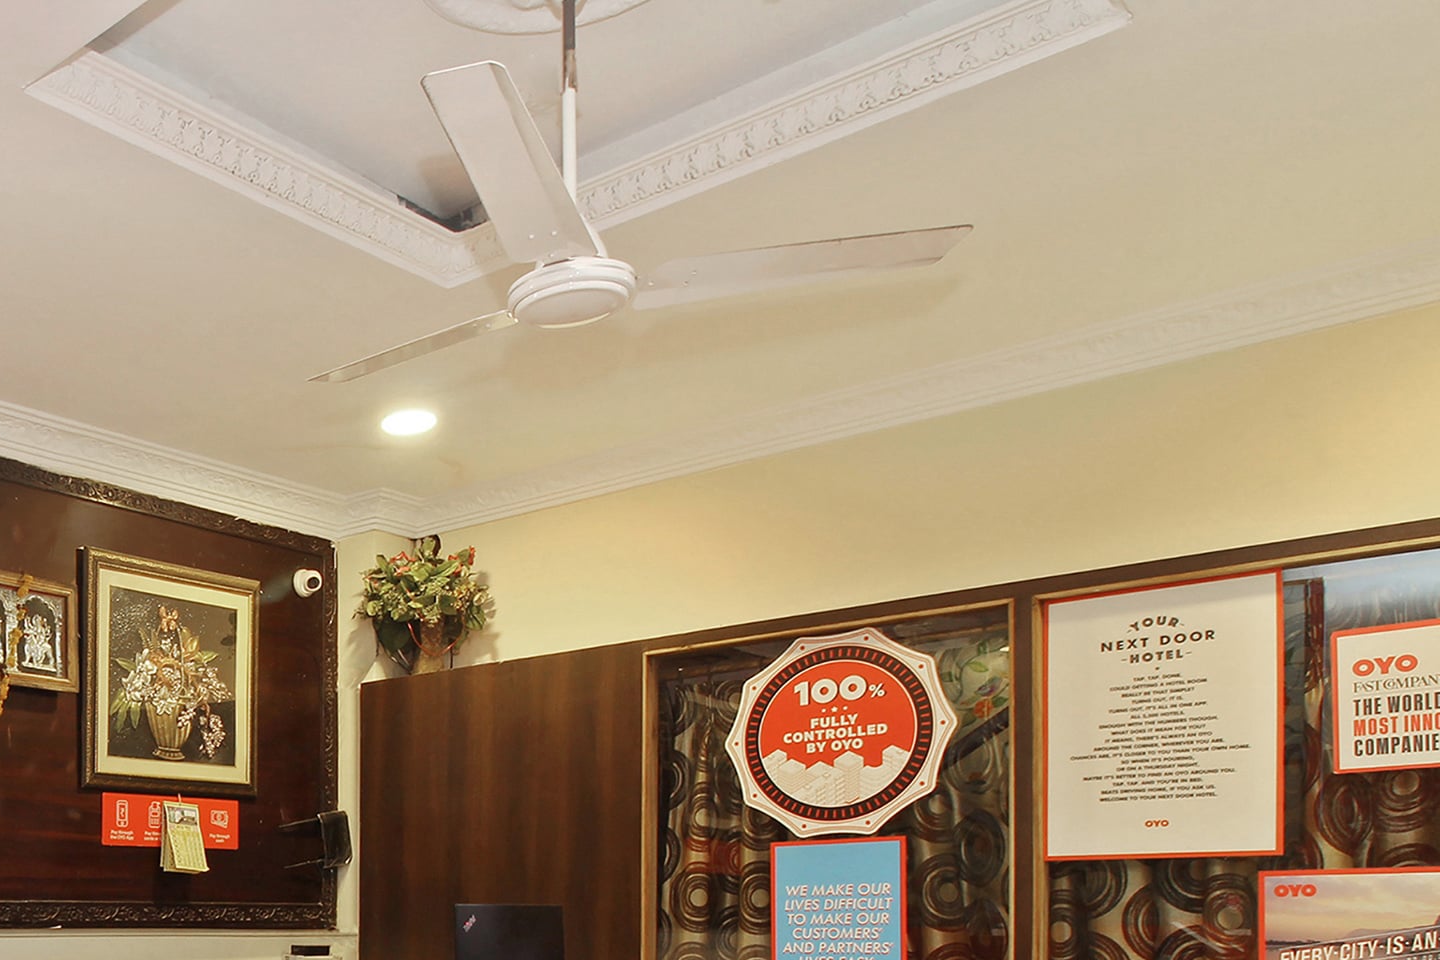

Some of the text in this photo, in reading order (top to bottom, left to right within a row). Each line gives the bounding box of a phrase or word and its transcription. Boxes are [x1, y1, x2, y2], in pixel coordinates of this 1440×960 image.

[1130, 616, 1179, 632] YOUR
[1100, 630, 1215, 653] NEXT DOOR
[1130, 649, 1184, 664] HOTEL
[1352, 655, 1418, 677] OYO
[794, 675, 886, 707] 100%
[1353, 698, 1382, 716] THE
[810, 713, 859, 730] FULLY
[1354, 716, 1398, 736] MOST
[783, 723, 888, 744] CONTROLLED
[806, 738, 863, 754] BY OYO
[1354, 733, 1440, 757] COMPANIE
[1145, 820, 1169, 828] OYO
[785, 882, 892, 898] WE MAKE OUR
[1274, 884, 1317, 897] OYO
[784, 897, 894, 912] LIVES DIFFICULT
[787, 913, 890, 926] TO MAKE OUR
[783, 942, 815, 955] AND
